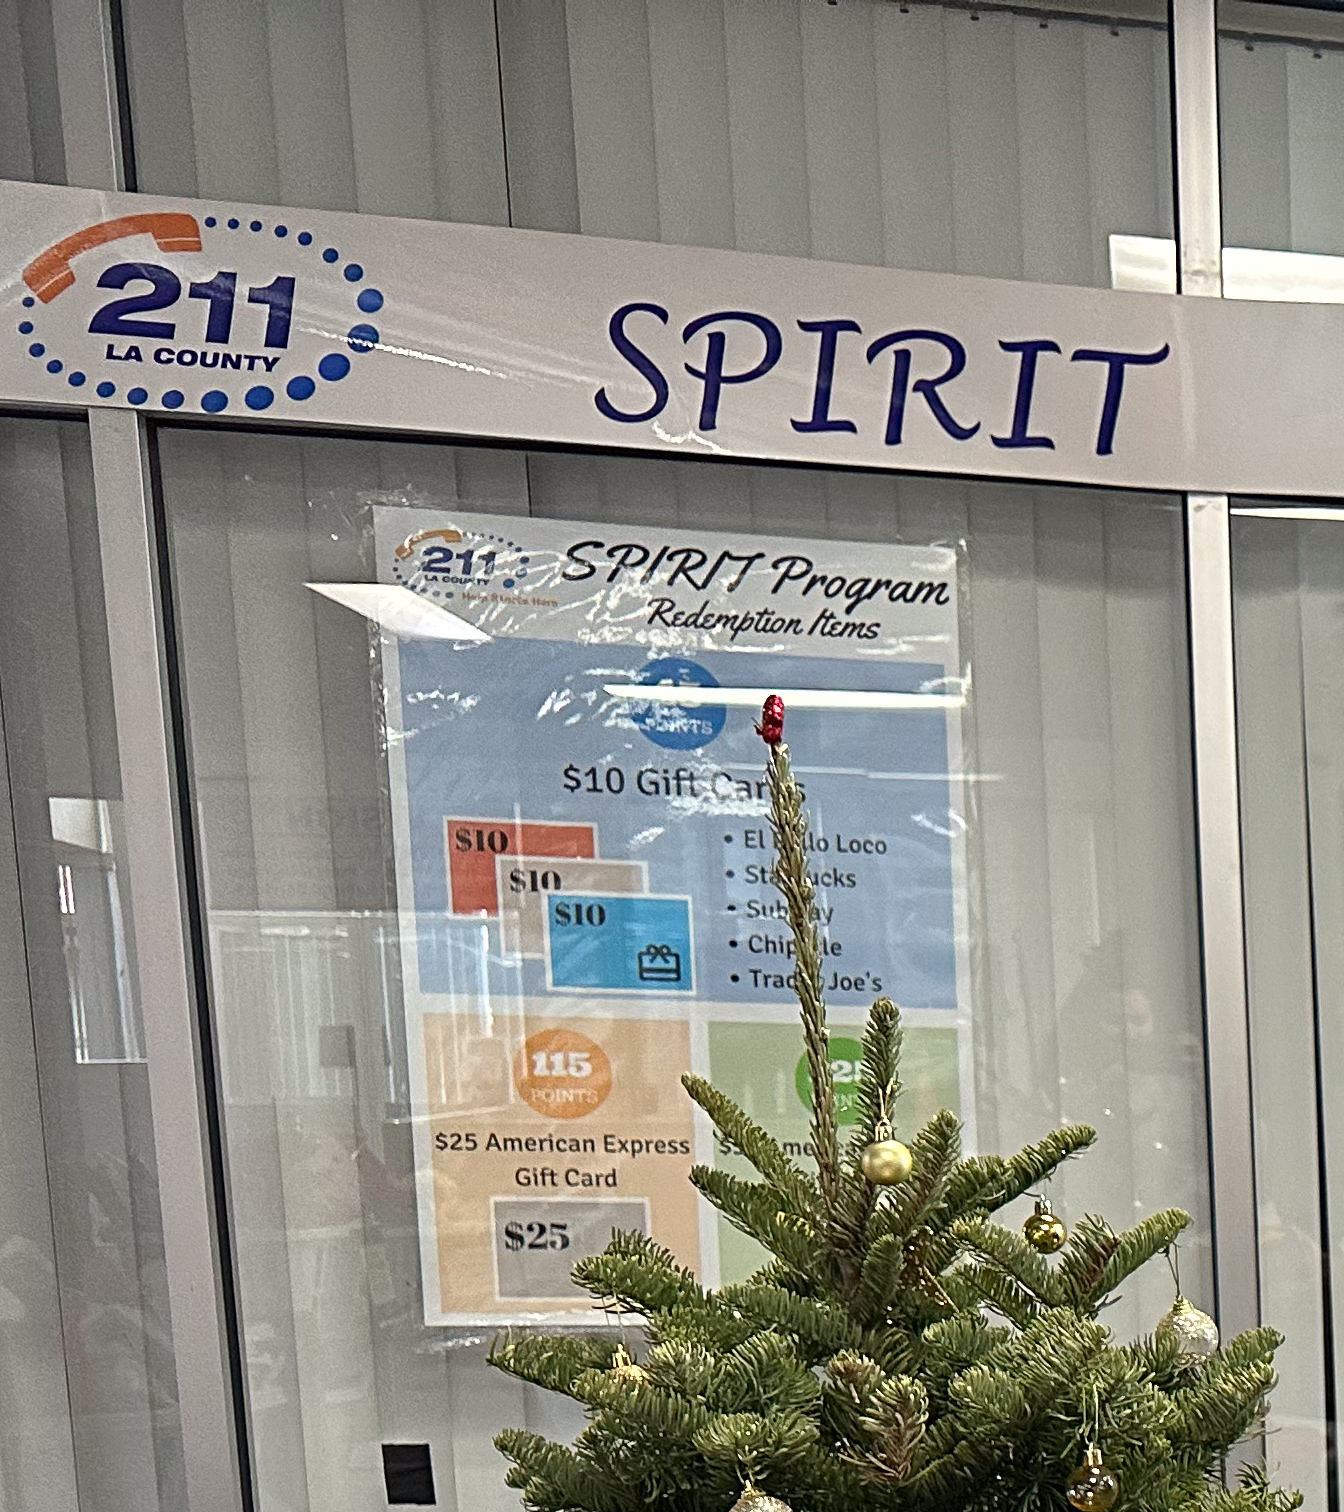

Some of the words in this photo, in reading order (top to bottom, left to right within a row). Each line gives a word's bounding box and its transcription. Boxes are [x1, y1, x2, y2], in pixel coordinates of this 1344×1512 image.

[88, 262, 296, 349] 211
[106, 344, 143, 363] LA
[153, 347, 281, 372] COUNTY
[594, 301, 1170, 457] SPIRIT
[421, 546, 496, 576] 211
[561, 540, 767, 594] SPIRIT
[770, 555, 951, 614] Program
[647, 599, 804, 641] Redemption
[806, 608, 881, 641] Items
[562, 763, 626, 797] $10
[708, 772, 807, 802] Cars
[455, 828, 509, 854] $10
[744, 829, 766, 849] El
[836, 834, 888, 855] Loco
[509, 867, 562, 893] $10
[744, 864, 857, 889] Staucks
[554, 902, 606, 928] $10
[746, 898, 834, 926] Subay
[748, 934, 843, 960] Chiple
[828, 971, 883, 993] Joe's
[531, 1052, 592, 1079] 115
[434, 1132, 479, 1156] $25
[486, 1133, 596, 1156] American
[602, 1134, 692, 1160] Express
[514, 1166, 558, 1189] Gift
[564, 1167, 618, 1188] Card
[503, 1220, 571, 1253] $25
